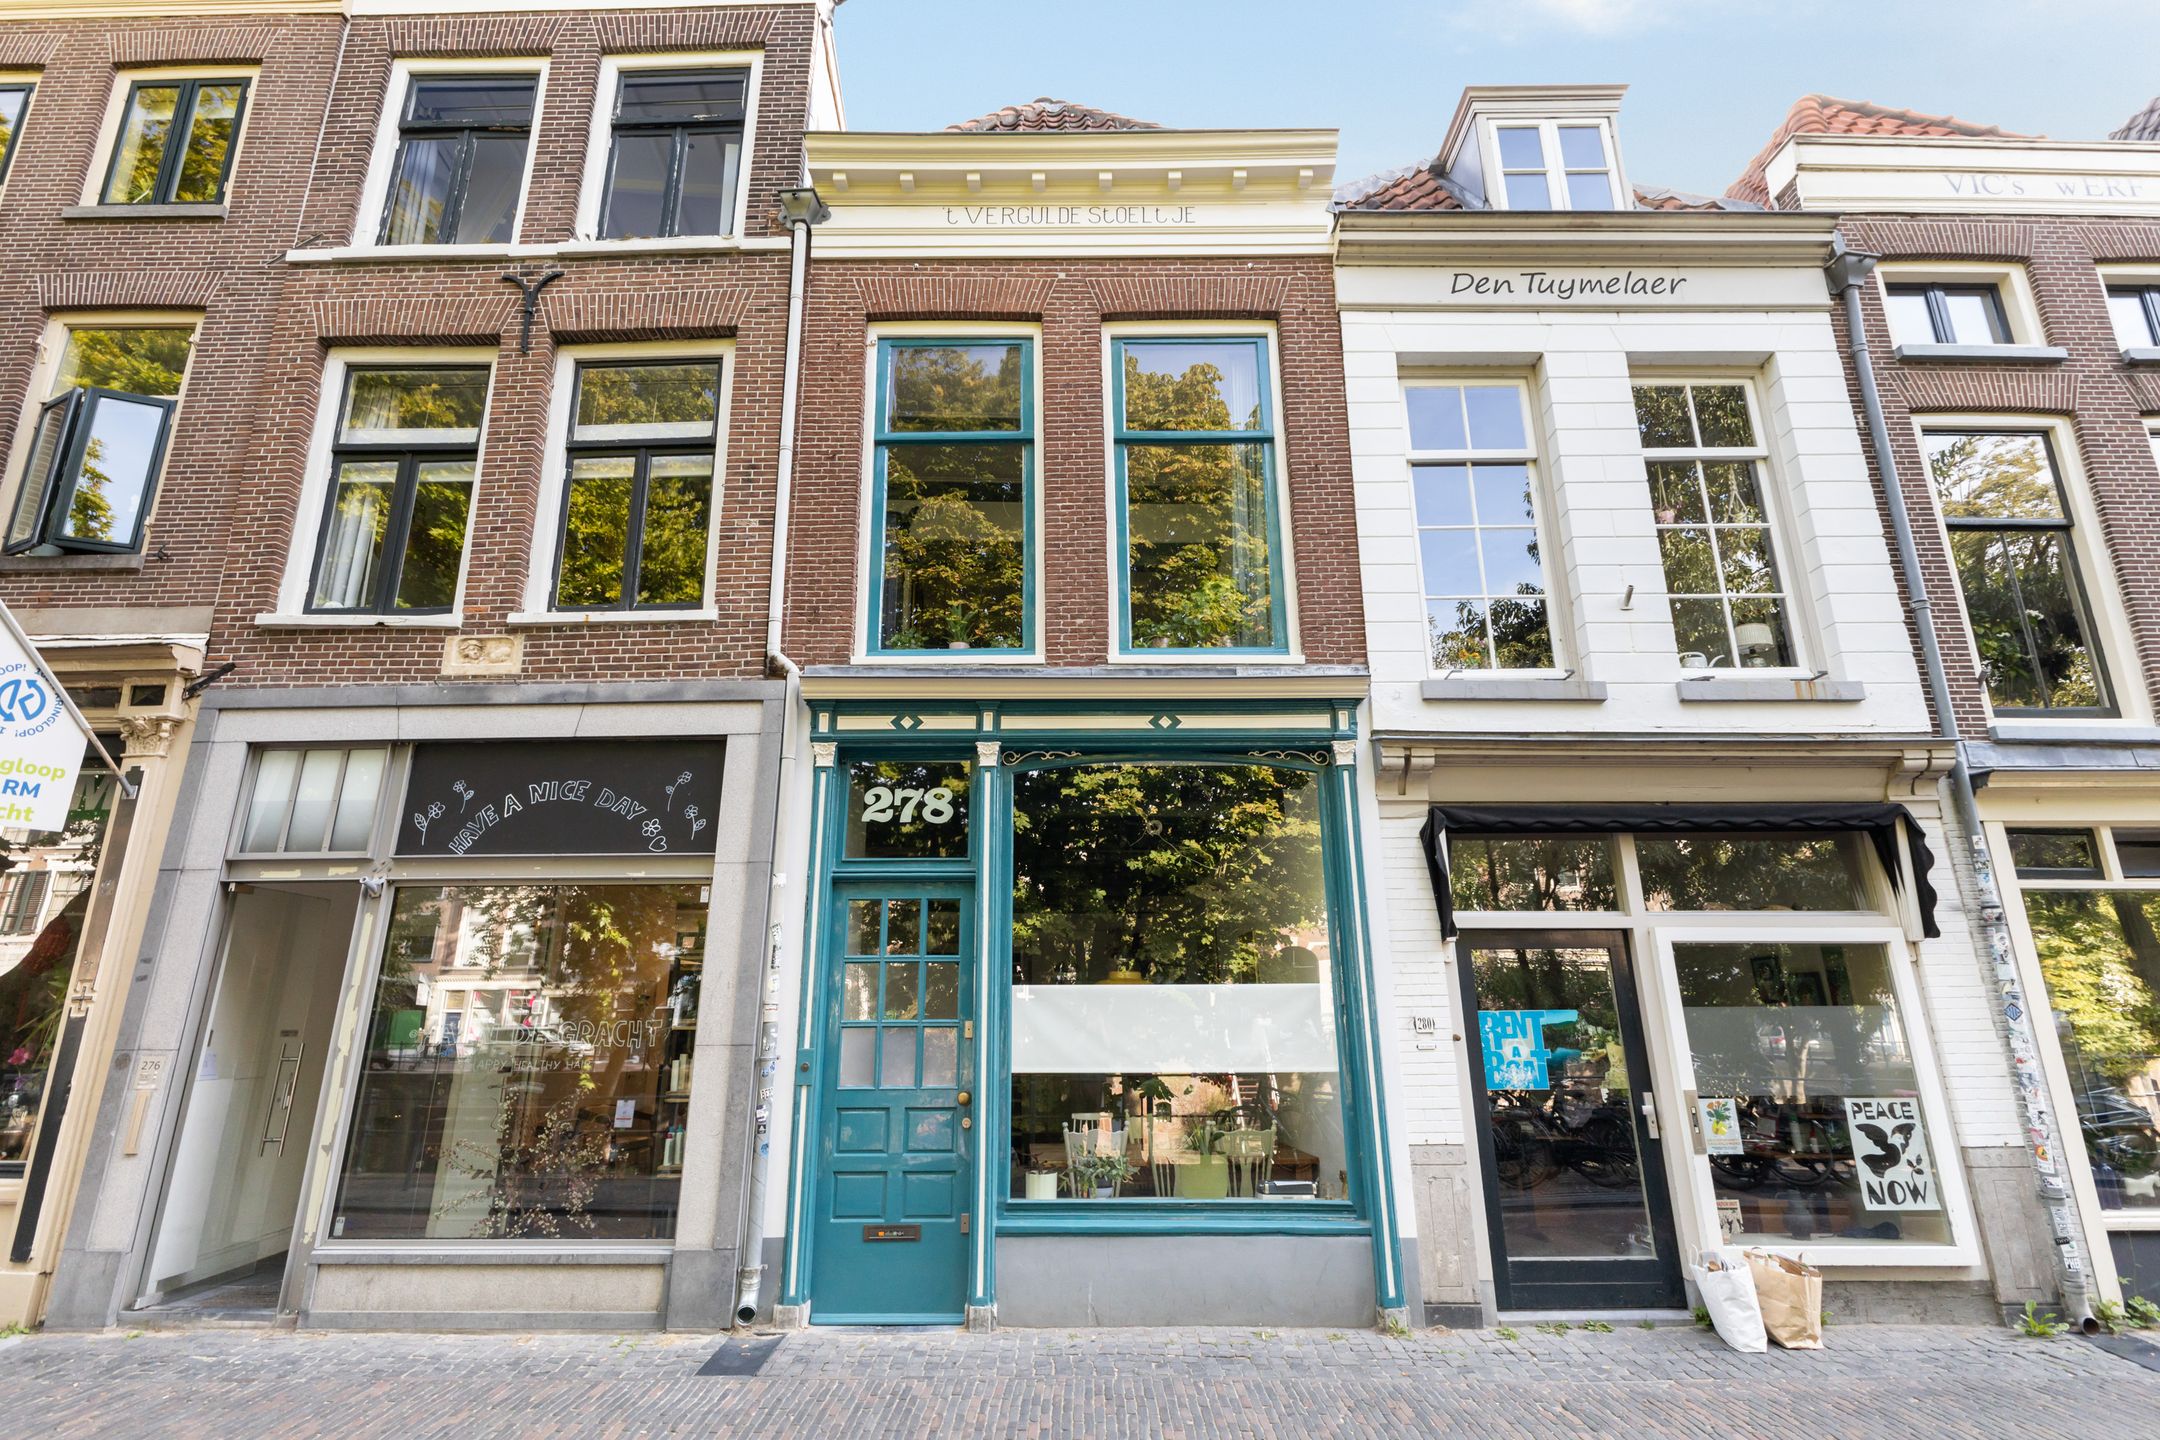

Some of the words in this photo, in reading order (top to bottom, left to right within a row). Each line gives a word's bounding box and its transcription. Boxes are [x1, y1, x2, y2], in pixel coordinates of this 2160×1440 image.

[965, 206, 1082, 225] VERGULDE
[1450, 272, 1514, 295] Den
[1520, 270, 1687, 300] Tuymelaer
[2, 779, 41, 798] RM
[861, 786, 954, 824] 278
[448, 804, 501, 856] HAVE
[503, 793, 524, 818] A
[528, 780, 592, 804] NICE
[594, 787, 647, 821] DAY
[558, 1018, 664, 1049] GRACHT
[1417, 1017, 1432, 1030] 280
[1512, 1046, 1521, 1058] A
[141, 1060, 161, 1071] 276
[1851, 1101, 1915, 1121] PEACE
[1866, 1180, 1928, 1205] NOW
